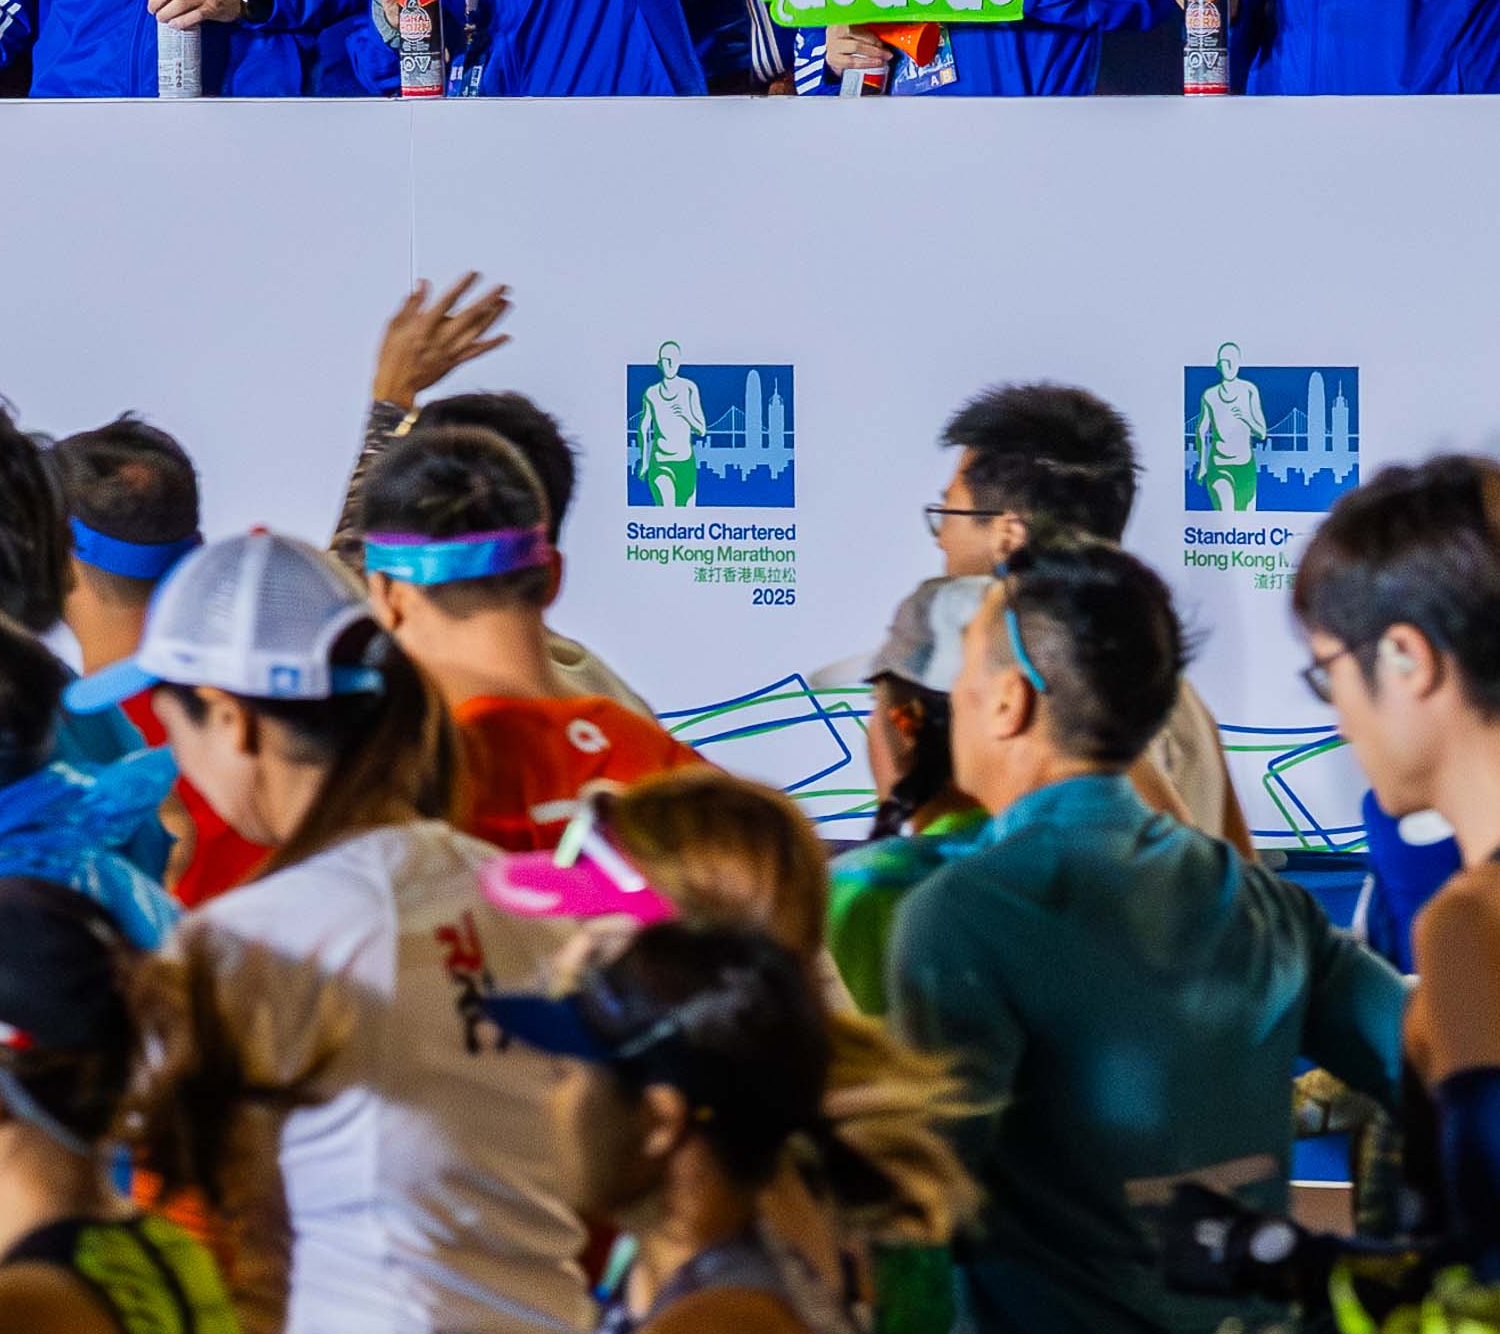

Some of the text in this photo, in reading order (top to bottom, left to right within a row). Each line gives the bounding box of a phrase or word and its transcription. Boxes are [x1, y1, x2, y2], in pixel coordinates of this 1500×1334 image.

[626, 522, 796, 540] Standard Chartered
[1184, 527, 1266, 545] Standard
[627, 545, 796, 564] Hong Kong Marathon
[1184, 550, 1276, 572] Hong Kong
[694, 566, 796, 583] 渣打香港馬拉松
[752, 588, 796, 606] 2025
